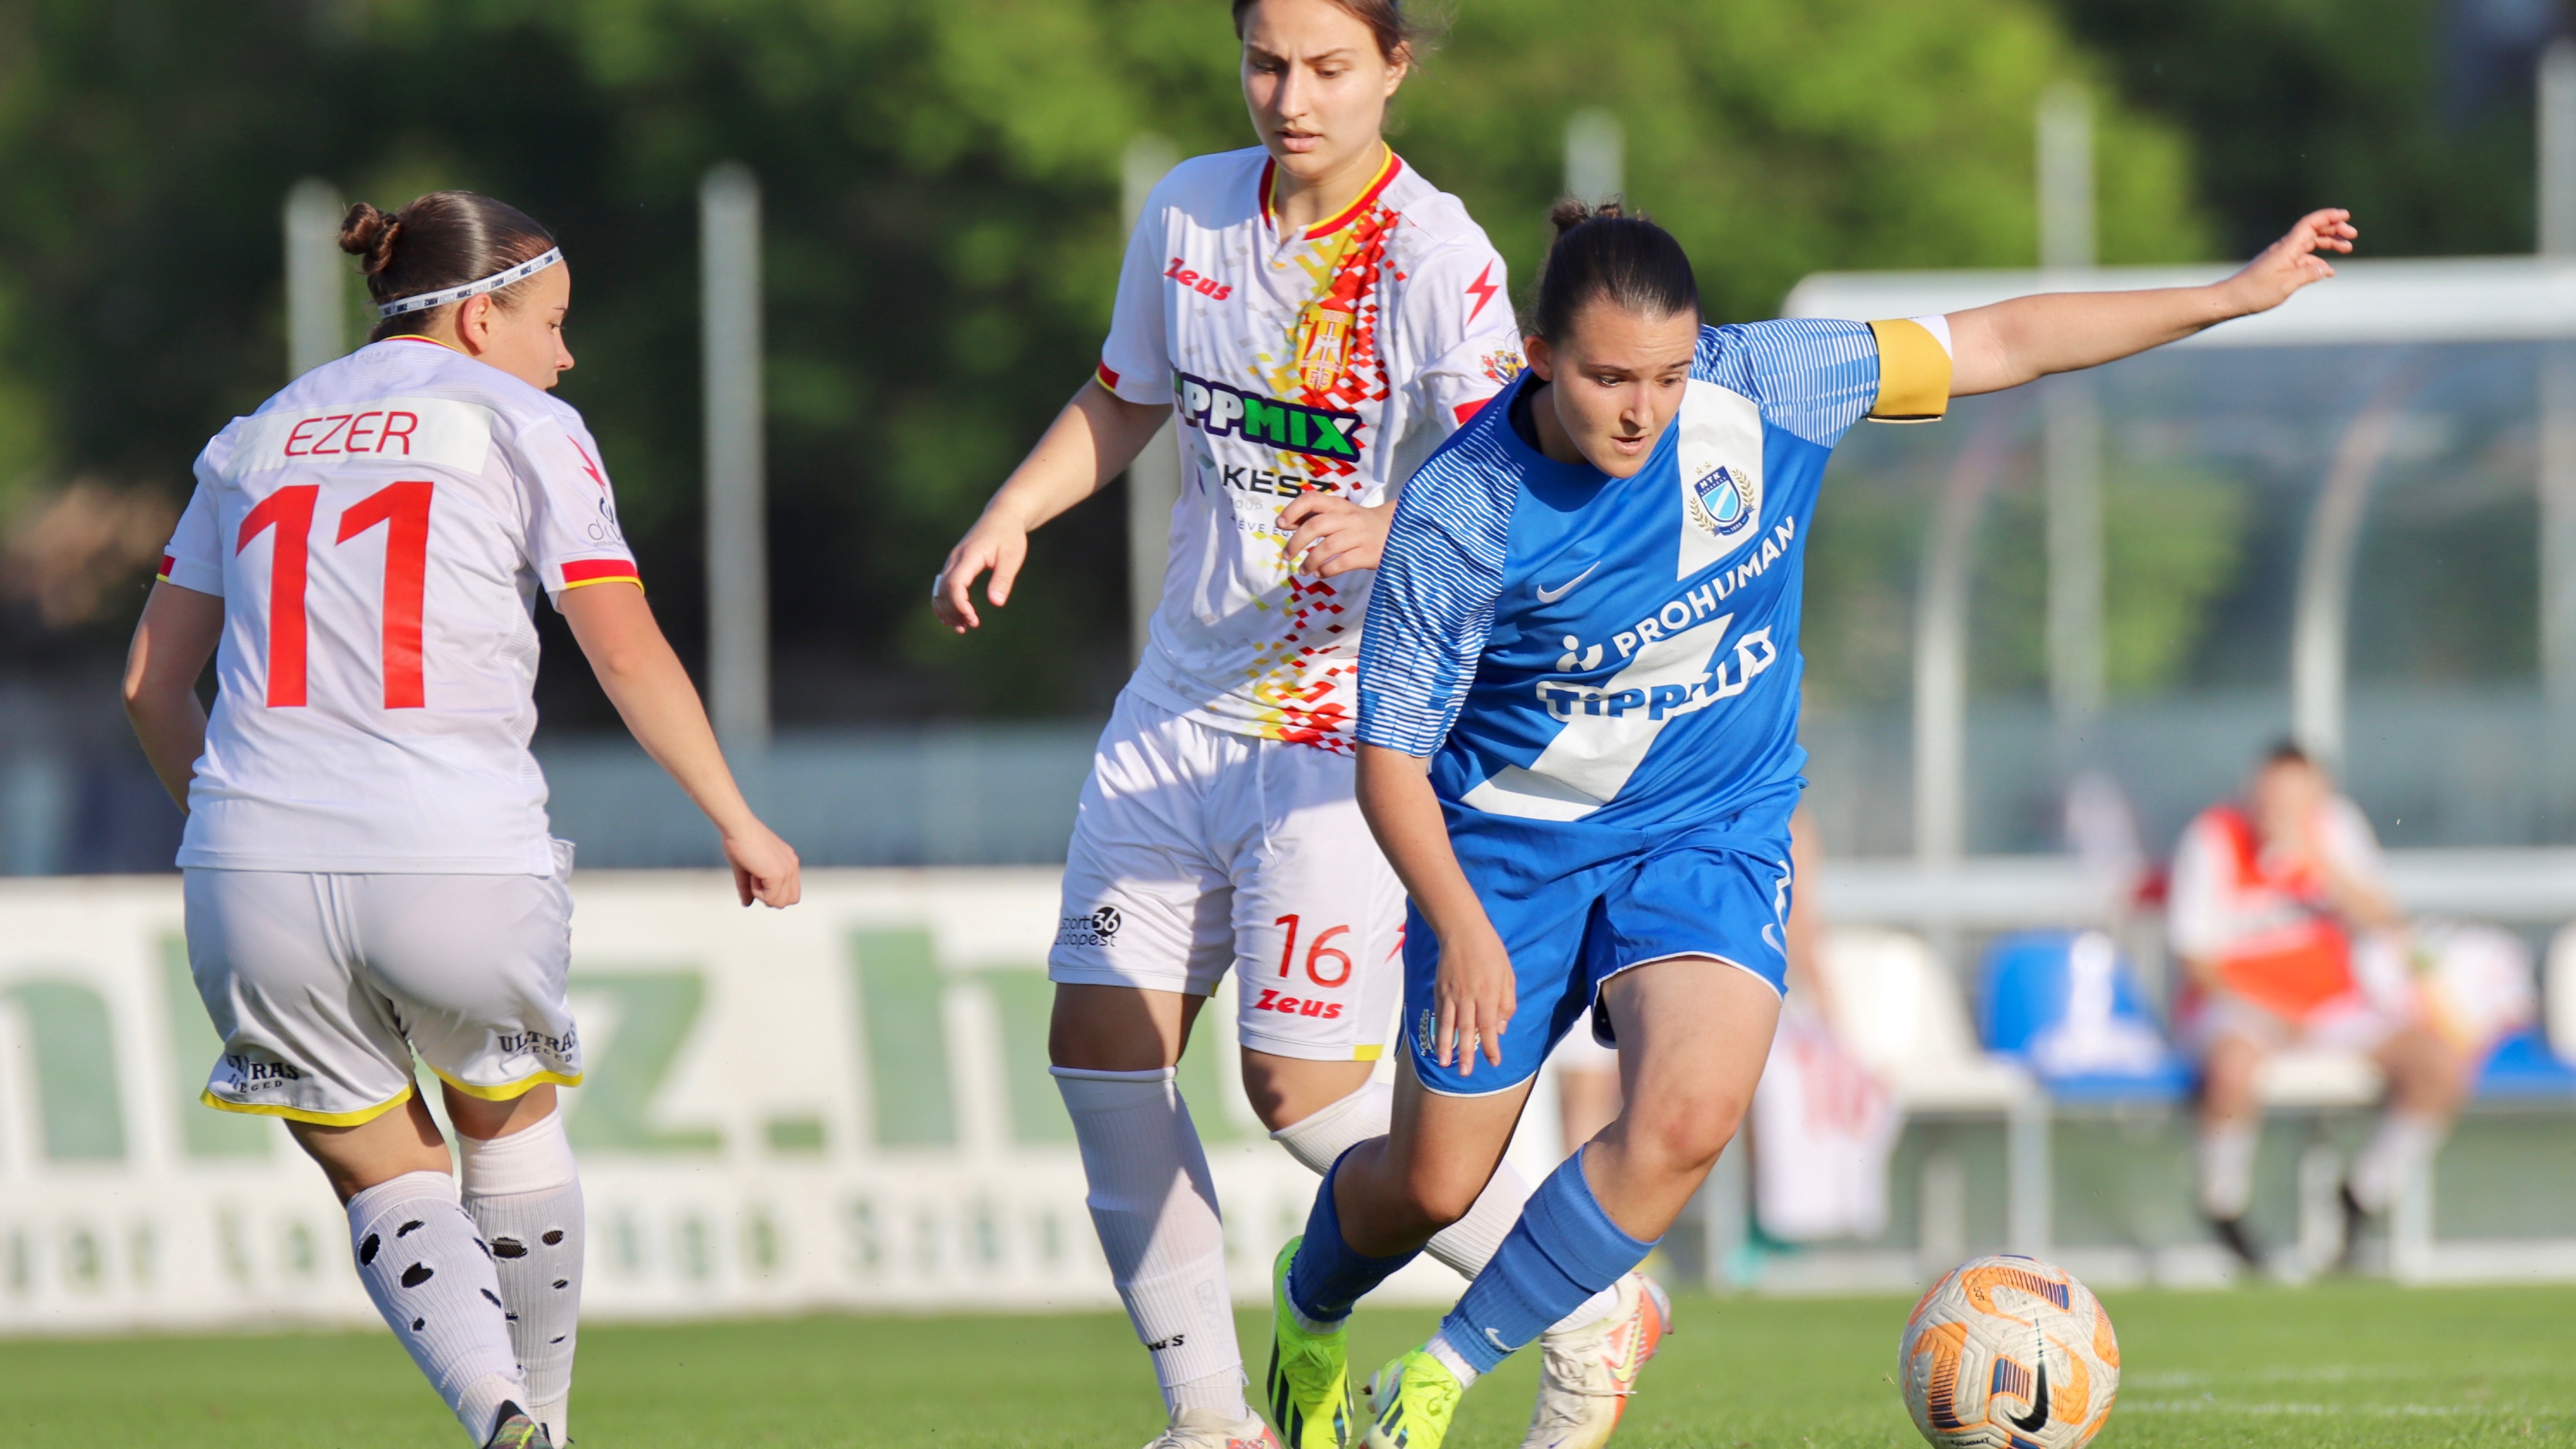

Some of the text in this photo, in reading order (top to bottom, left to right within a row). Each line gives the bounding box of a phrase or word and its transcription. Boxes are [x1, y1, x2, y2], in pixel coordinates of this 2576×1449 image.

[1163, 257, 1233, 301] Zeus
[284, 411, 418, 457] EZER
[1174, 372, 1357, 455] PPMIX
[1699, 472, 1721, 489] MTK
[235, 480, 434, 709] 11
[1613, 515, 1795, 659] PROHUMAN
[1093, 908, 1119, 933] 36
[1274, 913, 1352, 989] 16
[1255, 989, 1343, 1019] Zeus
